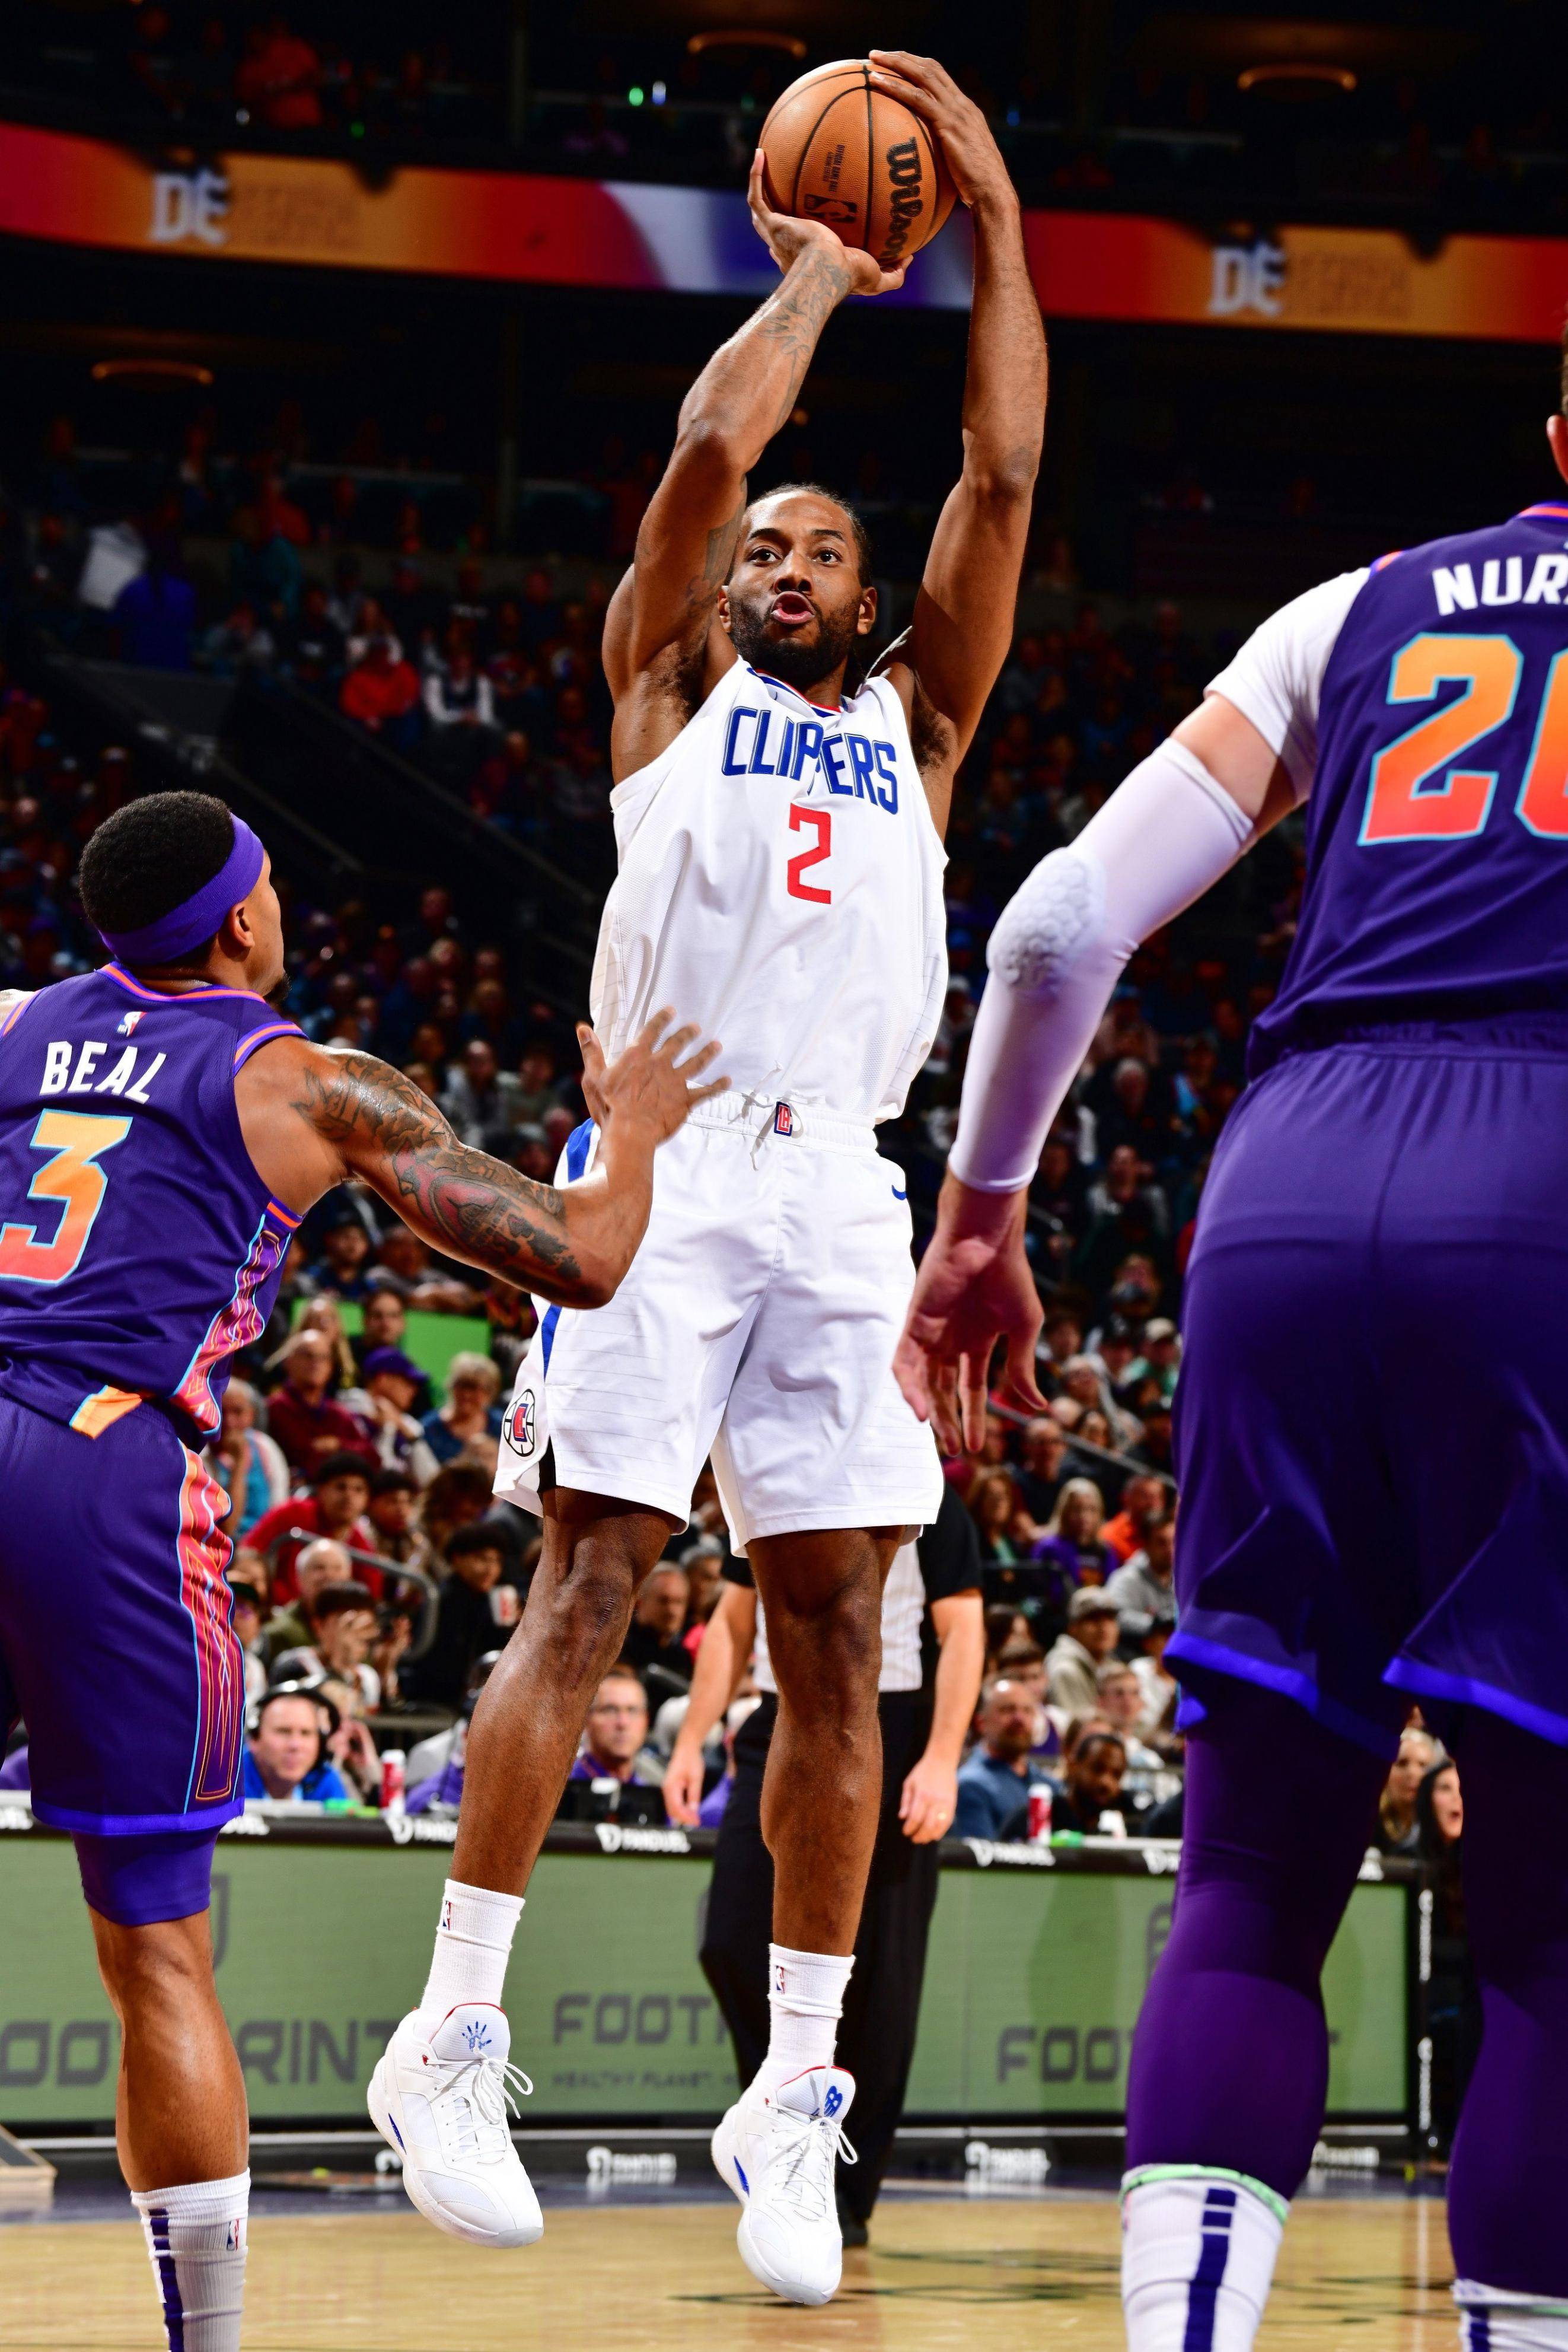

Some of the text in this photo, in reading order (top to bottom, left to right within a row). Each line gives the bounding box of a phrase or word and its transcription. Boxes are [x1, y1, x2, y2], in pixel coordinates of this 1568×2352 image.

[1432, 553, 1568, 617] NUR
[787, 802, 831, 905] 2
[39, 1040, 167, 1104] BEAL
[0, 1107, 133, 1285] 3
